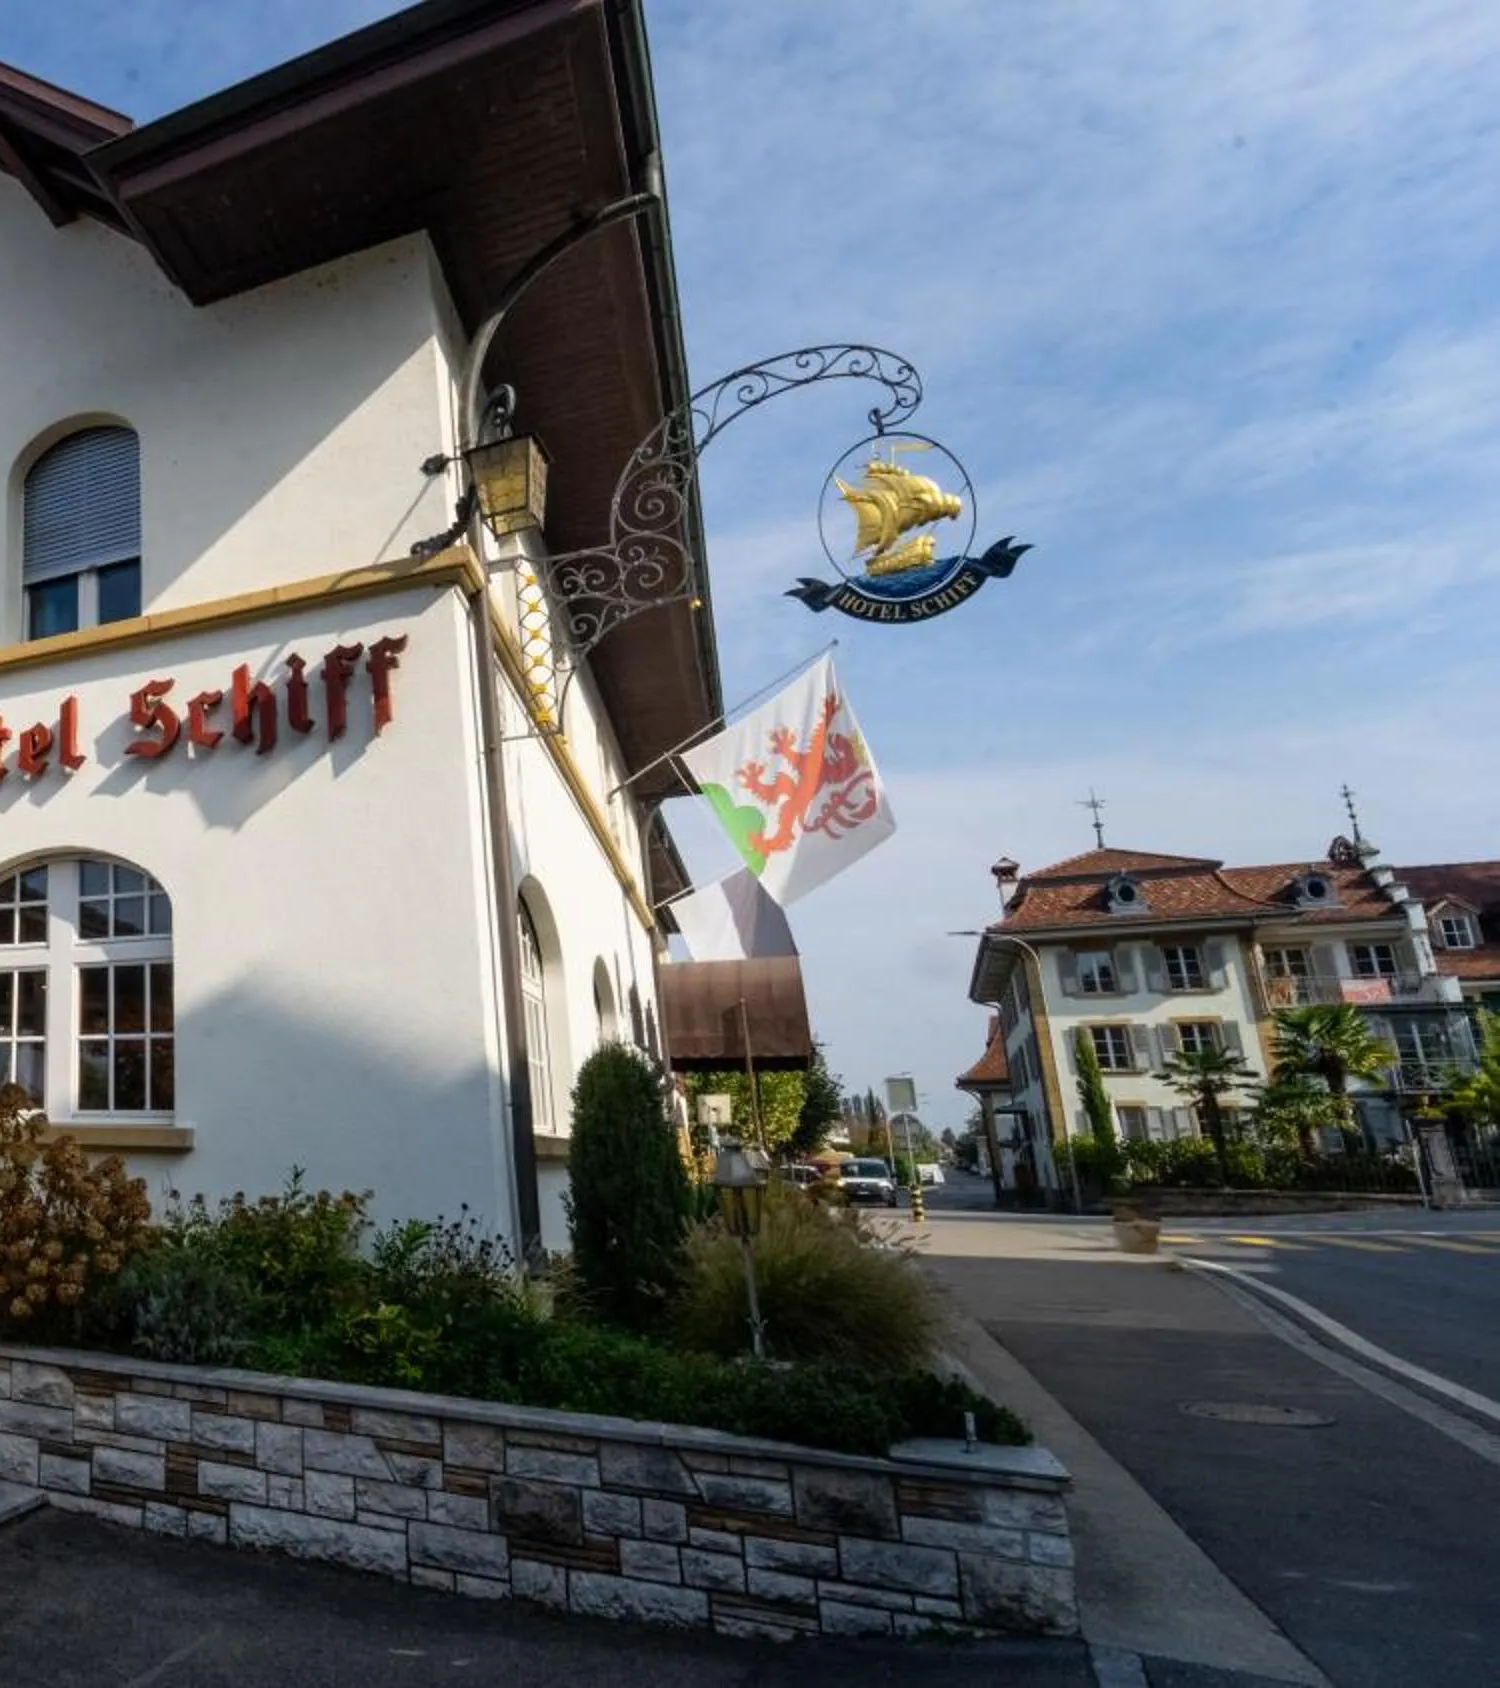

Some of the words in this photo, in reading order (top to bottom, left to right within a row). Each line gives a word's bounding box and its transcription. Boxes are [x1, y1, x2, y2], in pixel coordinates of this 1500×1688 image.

[839, 593, 906, 619] HOTEL
[910, 571, 978, 618] SCHIFF
[123, 633, 409, 760] Schiff
